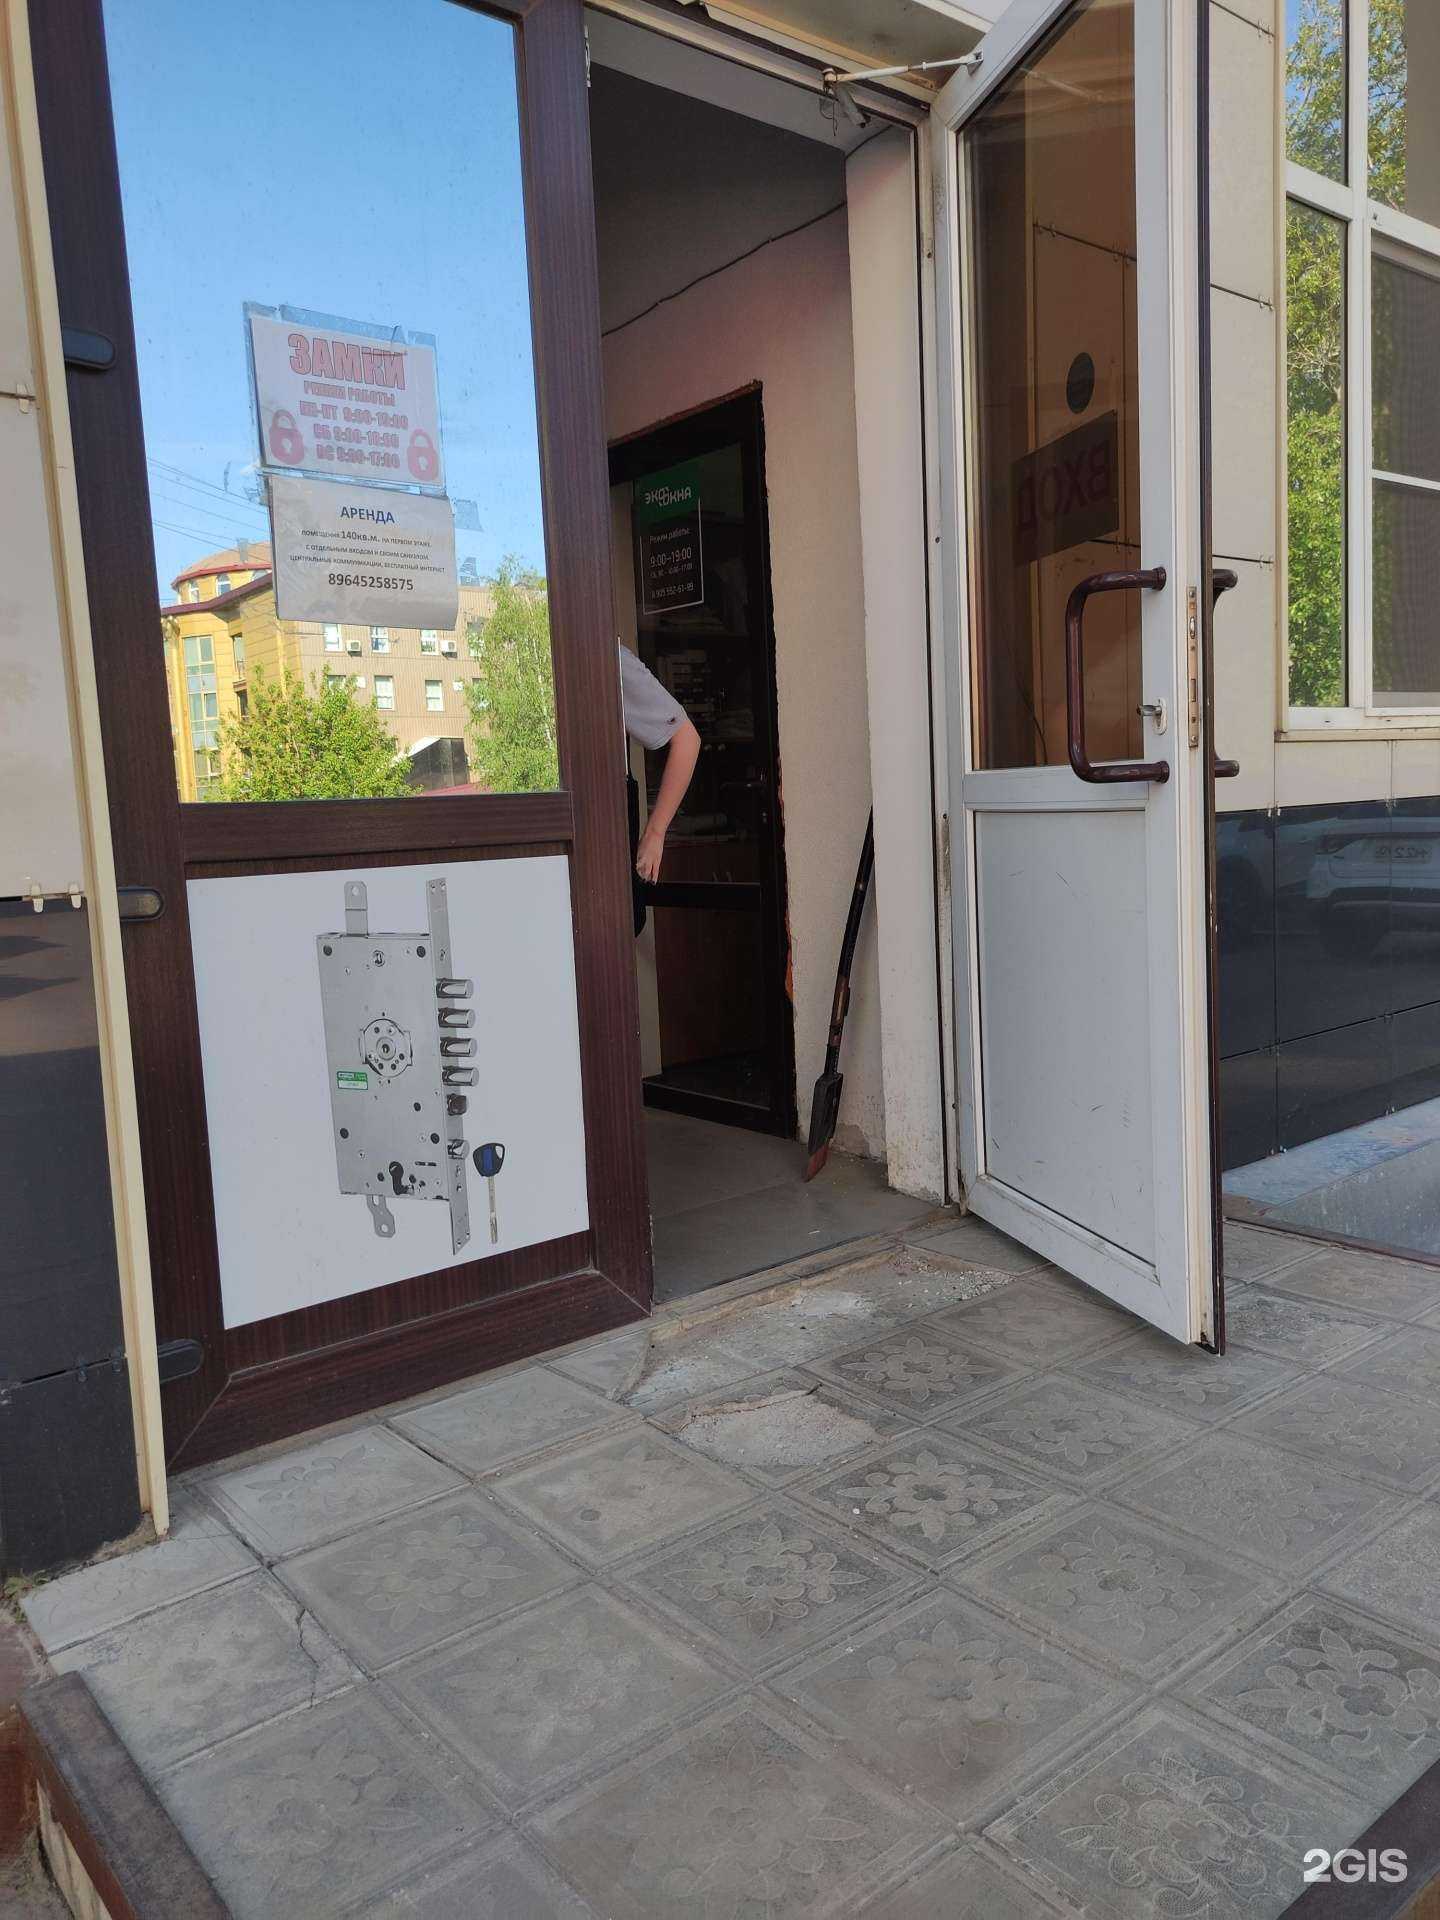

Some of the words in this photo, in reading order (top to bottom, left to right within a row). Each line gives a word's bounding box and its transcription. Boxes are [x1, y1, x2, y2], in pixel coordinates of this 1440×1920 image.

[287, 333, 406, 391] ЗАМКИ
[347, 387, 396, 407] РАБОТЫ
[340, 506, 395, 524] АРЕНДА
[341, 530, 380, 542] 140кв.м.
[328, 573, 415, 591] 89645258575
